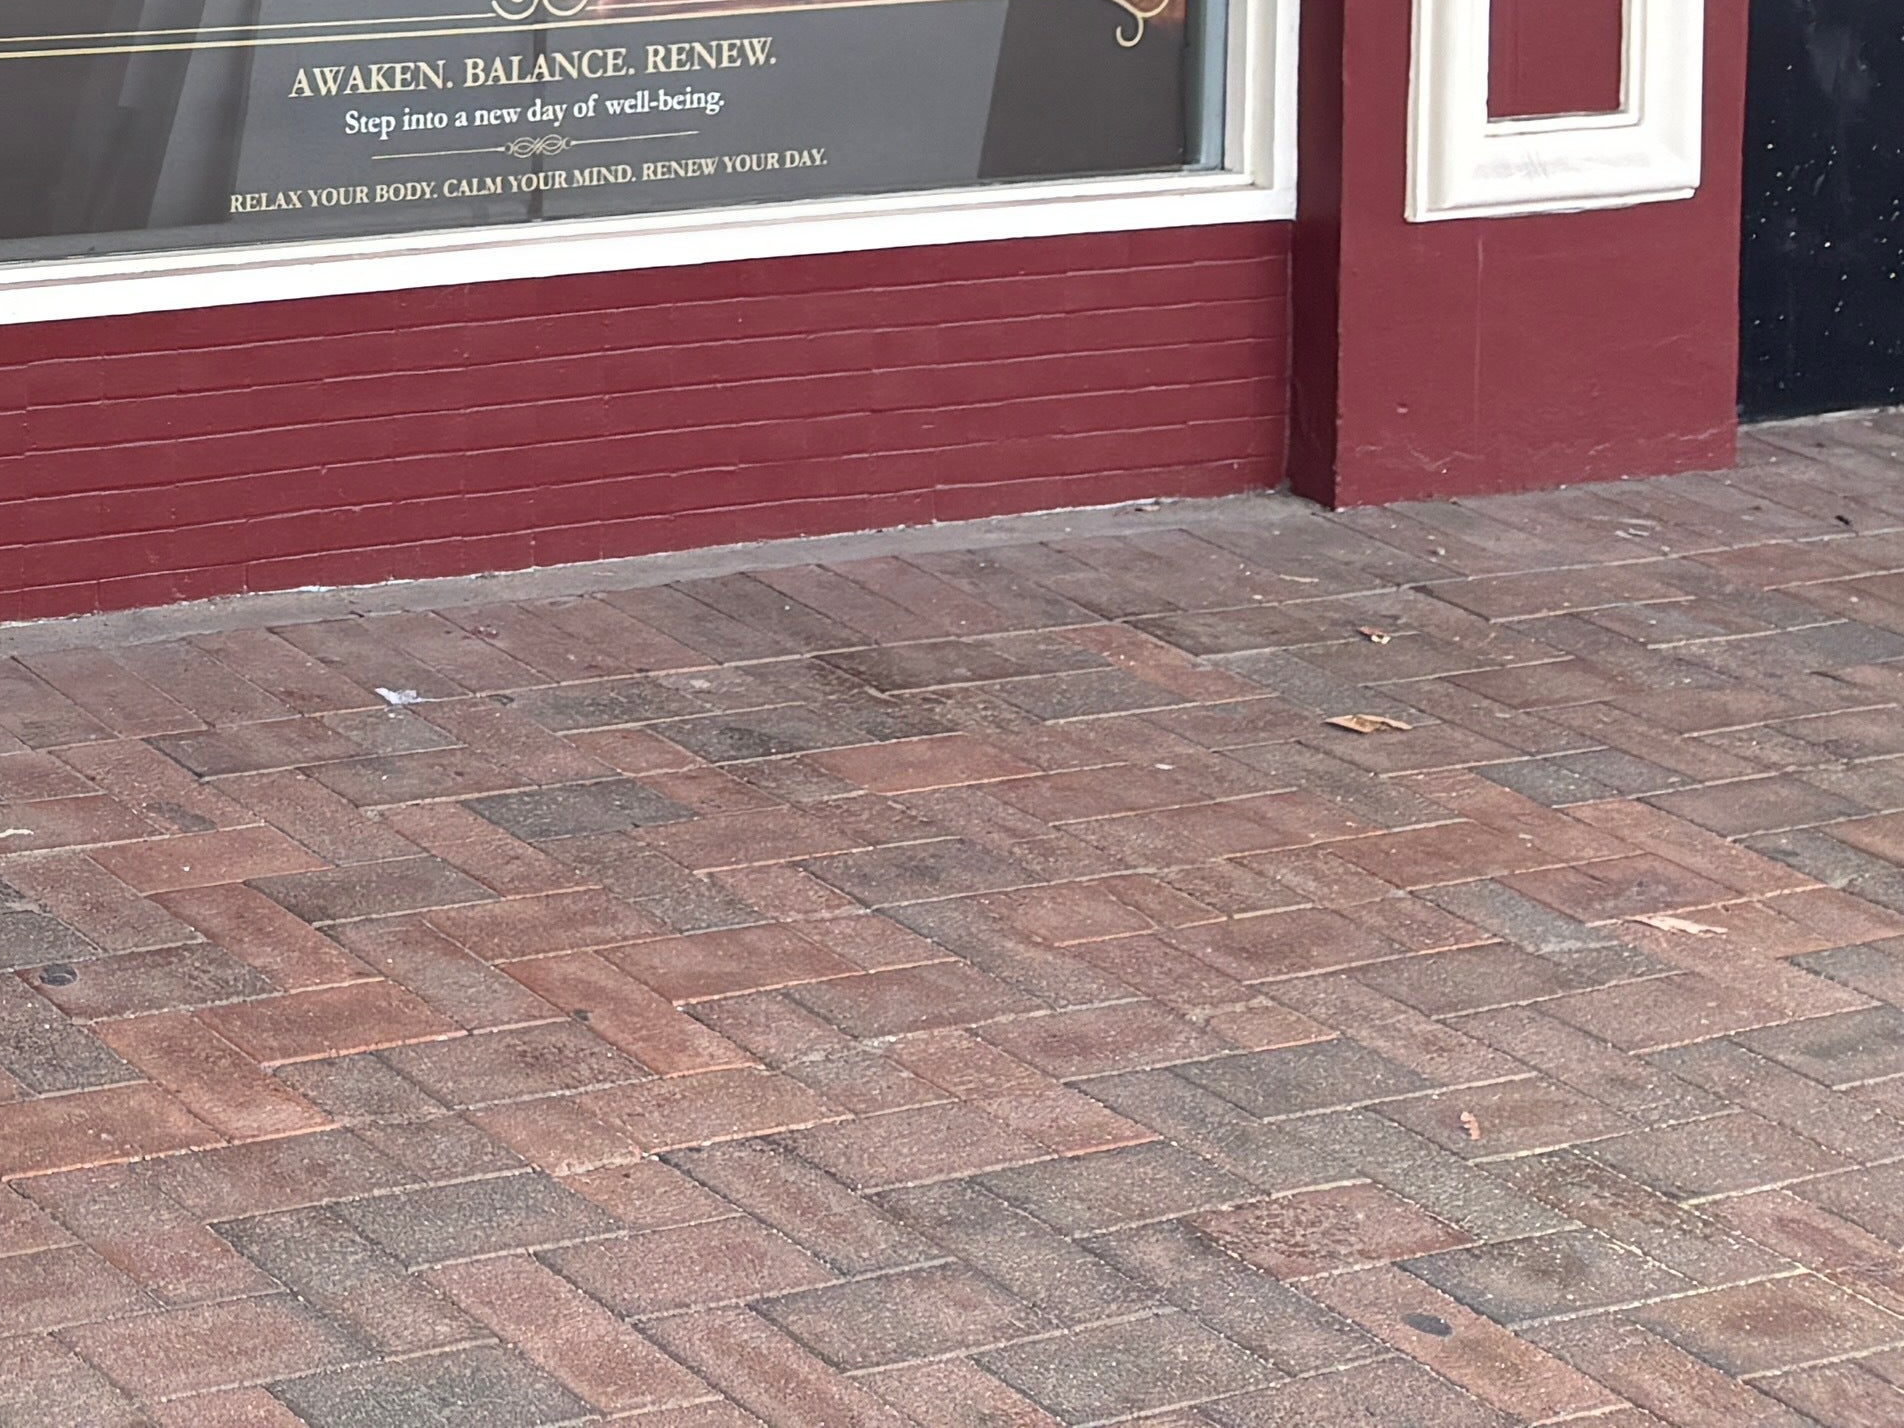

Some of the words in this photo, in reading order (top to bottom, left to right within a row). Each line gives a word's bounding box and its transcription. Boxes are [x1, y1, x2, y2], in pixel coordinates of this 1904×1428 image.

[289, 60, 453, 97] AWAKEN.
[464, 48, 635, 87] BALANCE.
[646, 37, 776, 73] RENEW.
[346, 111, 395, 140] Step
[403, 108, 447, 130] into
[455, 112, 468, 126] a
[474, 108, 521, 125] new
[527, 99, 567, 126] day
[574, 94, 598, 117] of
[605, 87, 724, 114] well-being.
[231, 191, 302, 212] RELAX
[308, 187, 369, 207] YOUR
[375, 182, 437, 202] BODY.
[444, 177, 502, 197] CALM
[508, 171, 568, 192] YOUR
[573, 165, 636, 187] MIND.
[642, 157, 718, 180] RENEW
[723, 153, 779, 172] YOUR
[785, 149, 827, 168] DAY.
